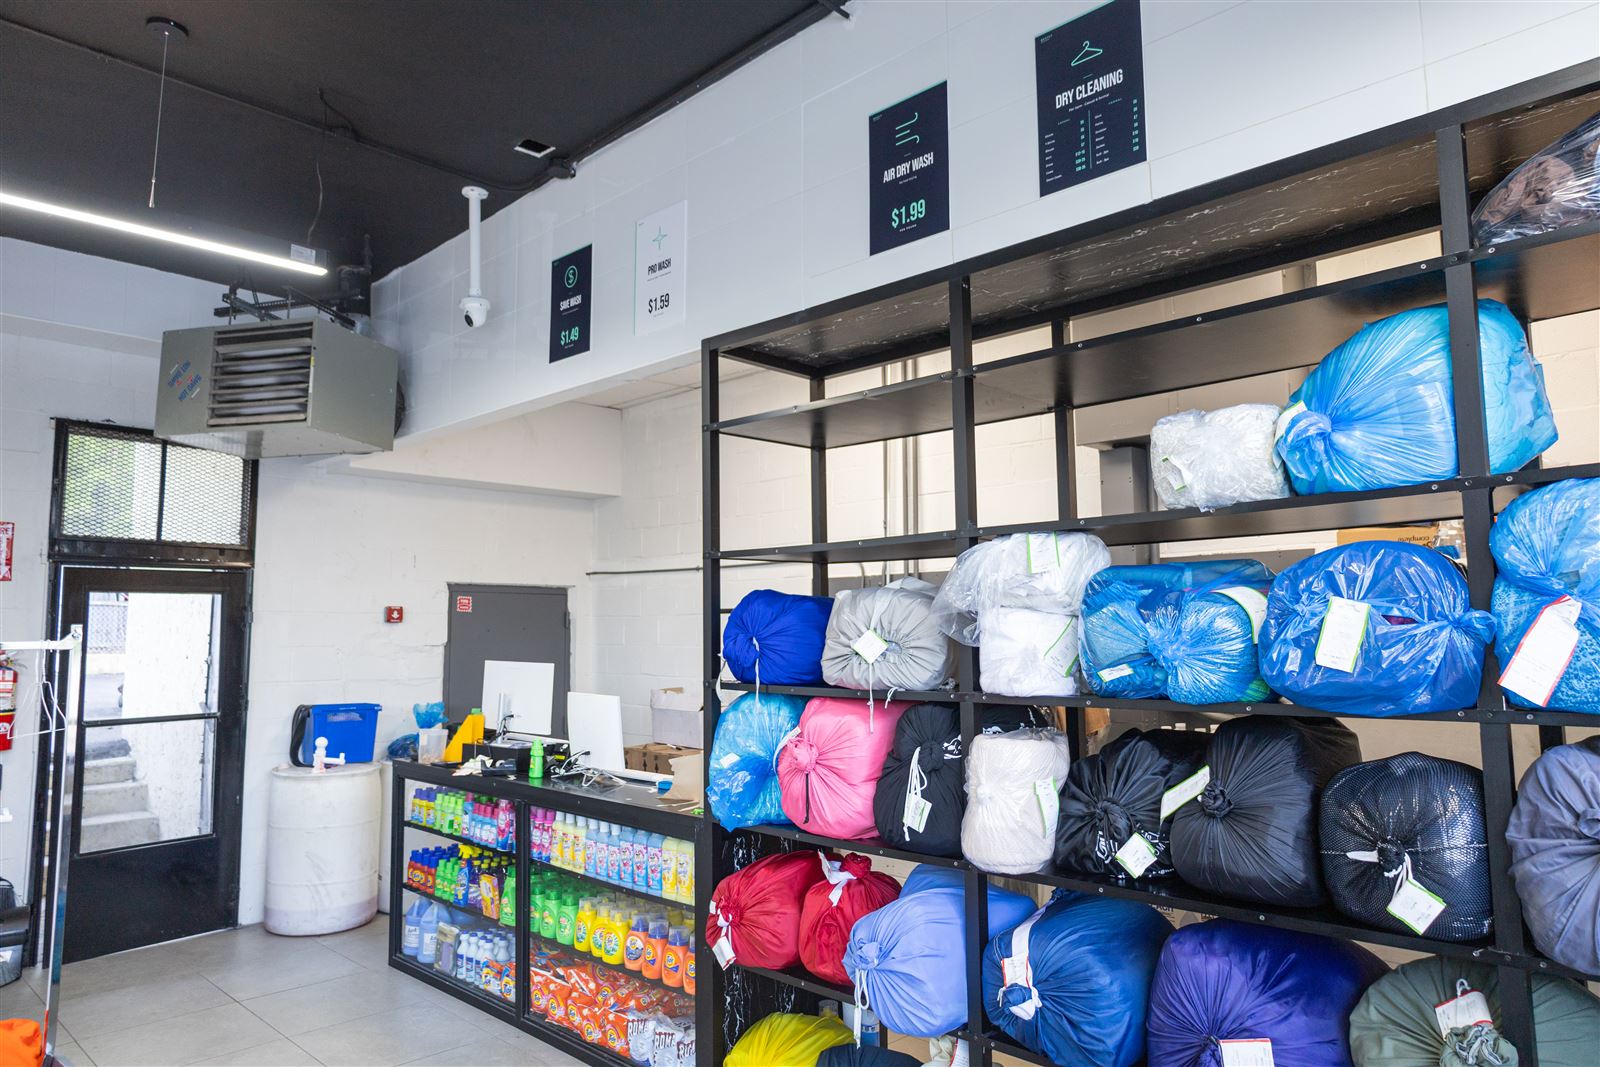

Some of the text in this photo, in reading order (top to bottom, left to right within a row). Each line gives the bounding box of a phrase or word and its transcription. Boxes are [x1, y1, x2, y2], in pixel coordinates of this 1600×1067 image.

[1055, 88, 1075, 109] DRY
[1075, 68, 1124, 101] CLEANING
[883, 167, 896, 184] AIR
[896, 160, 911, 178] DRY
[911, 152, 934, 172] WASH
[891, 198, 926, 229] $1.99
[647, 257, 672, 276] PRO WASH
[648, 293, 670, 314] $1.59
[560, 326, 579, 346] $1.49
